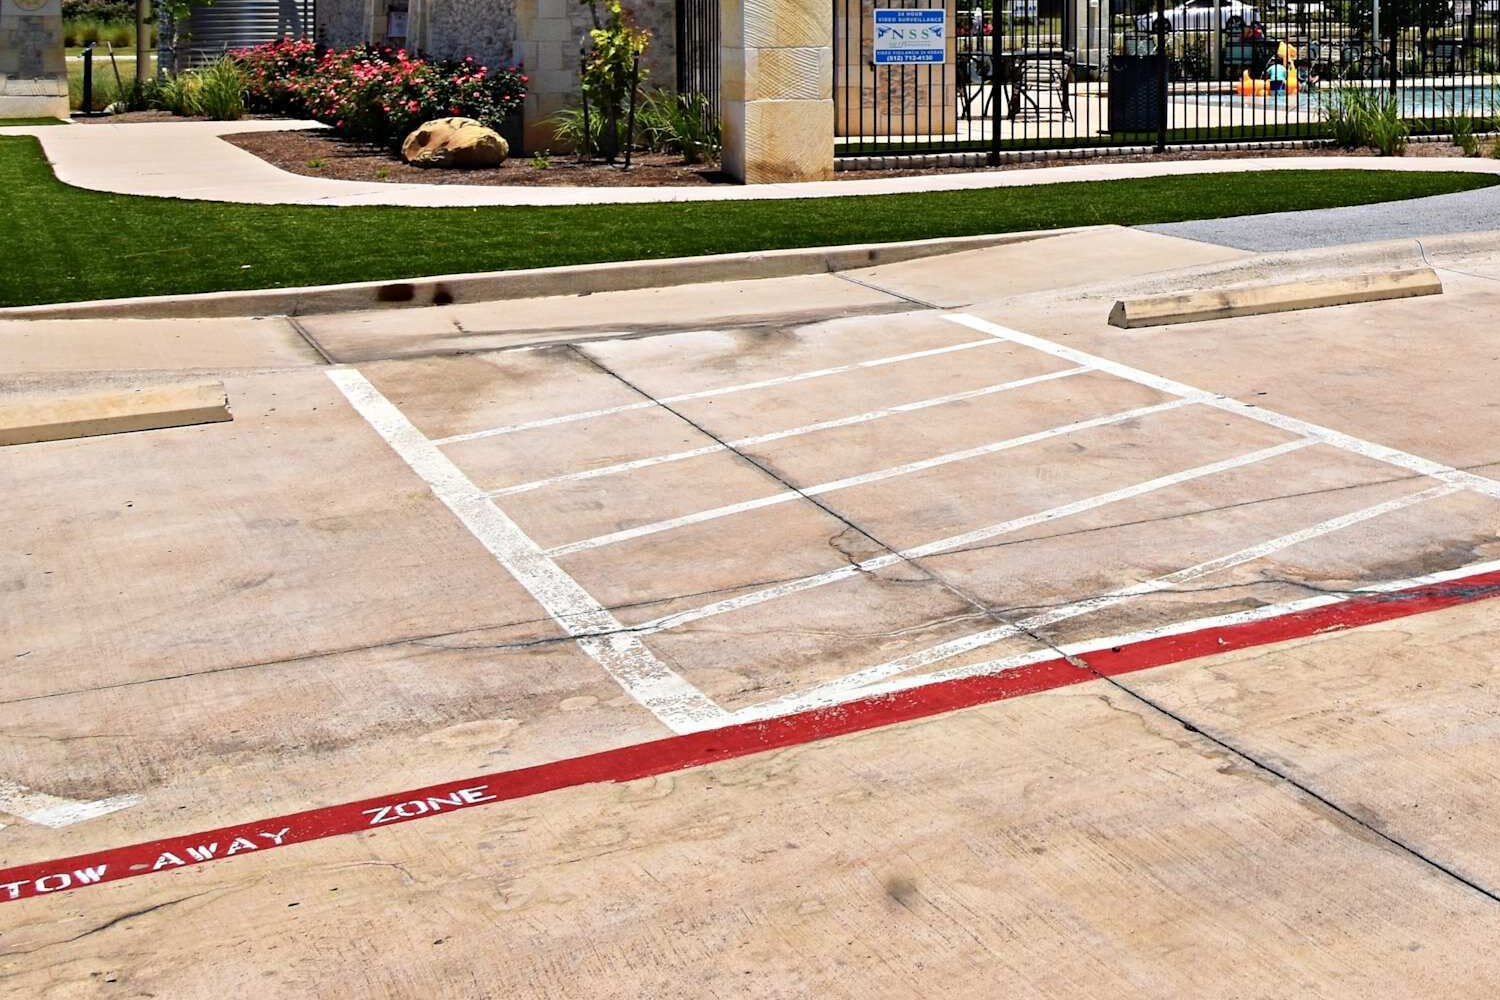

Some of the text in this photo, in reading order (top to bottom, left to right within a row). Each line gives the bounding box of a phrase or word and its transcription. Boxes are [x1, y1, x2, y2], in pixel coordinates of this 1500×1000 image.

[0, 784, 497, 899] TOW AWAY ZONE
